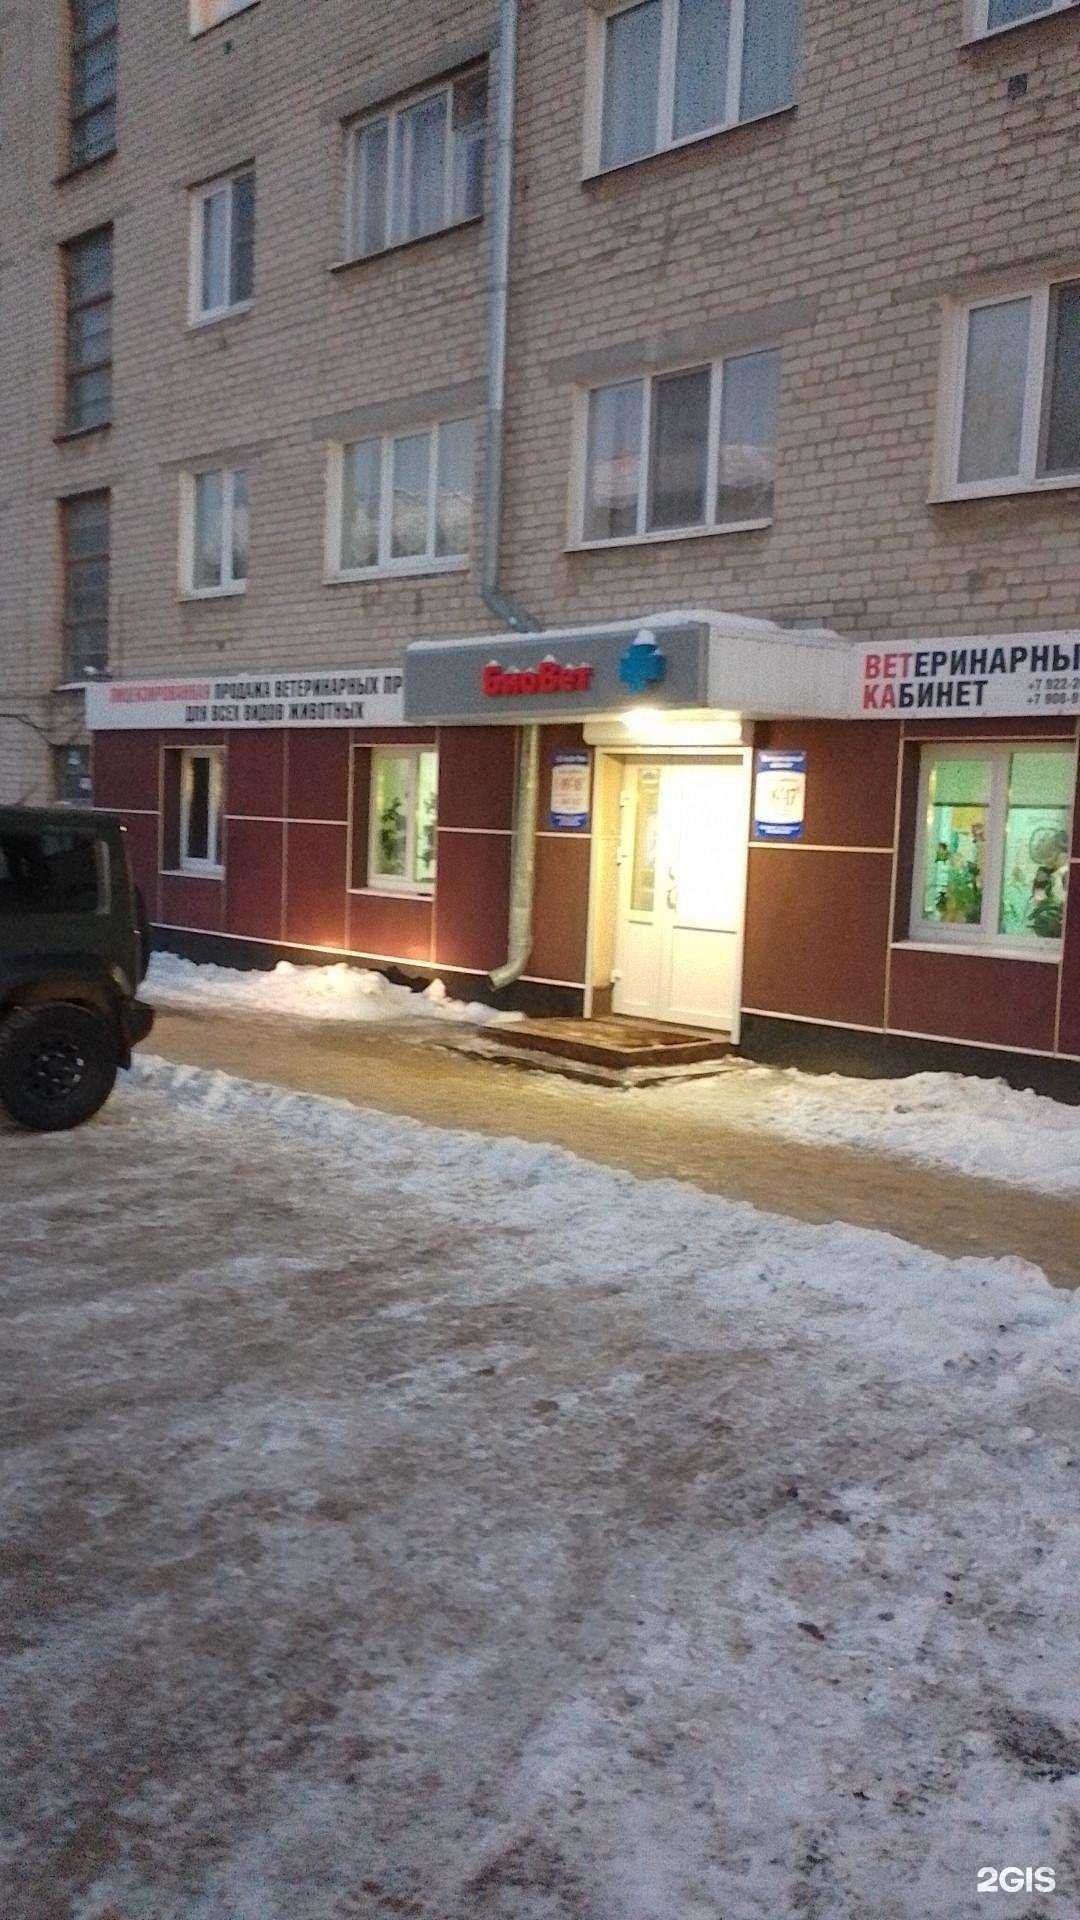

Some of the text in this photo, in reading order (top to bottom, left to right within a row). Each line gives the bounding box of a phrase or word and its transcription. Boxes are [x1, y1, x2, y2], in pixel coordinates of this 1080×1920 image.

[215, 681, 271, 700] ПРОДАЖА
[275, 678, 378, 698] ВЕТЕРИНАРНЫХ
[863, 680, 988, 709] КАБИНЕТ
[184, 701, 364, 722] ДЛЯ ВСЕХ ВИДОВ ЖИВОТНЫХ
